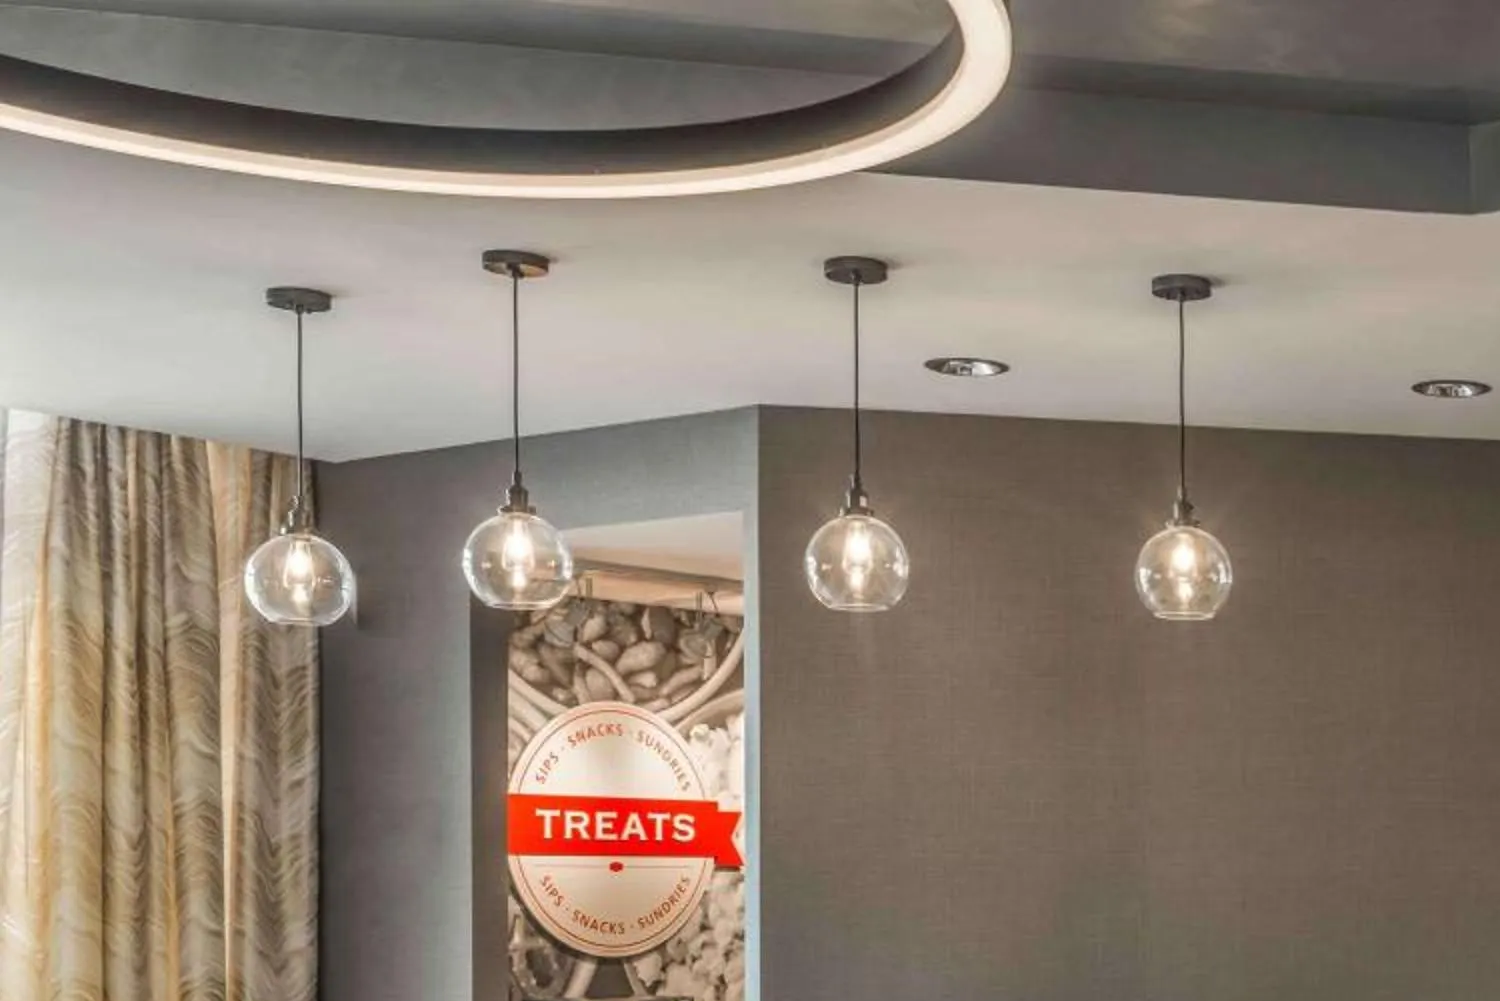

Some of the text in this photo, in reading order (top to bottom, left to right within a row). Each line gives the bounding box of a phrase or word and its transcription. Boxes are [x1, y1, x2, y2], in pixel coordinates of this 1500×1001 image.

[535, 723, 691, 792] SIPS SNACKS SUNDRIES
[535, 808, 697, 842] TREATS
[541, 875, 690, 935] SIPS SNACKS SUNDRIES
